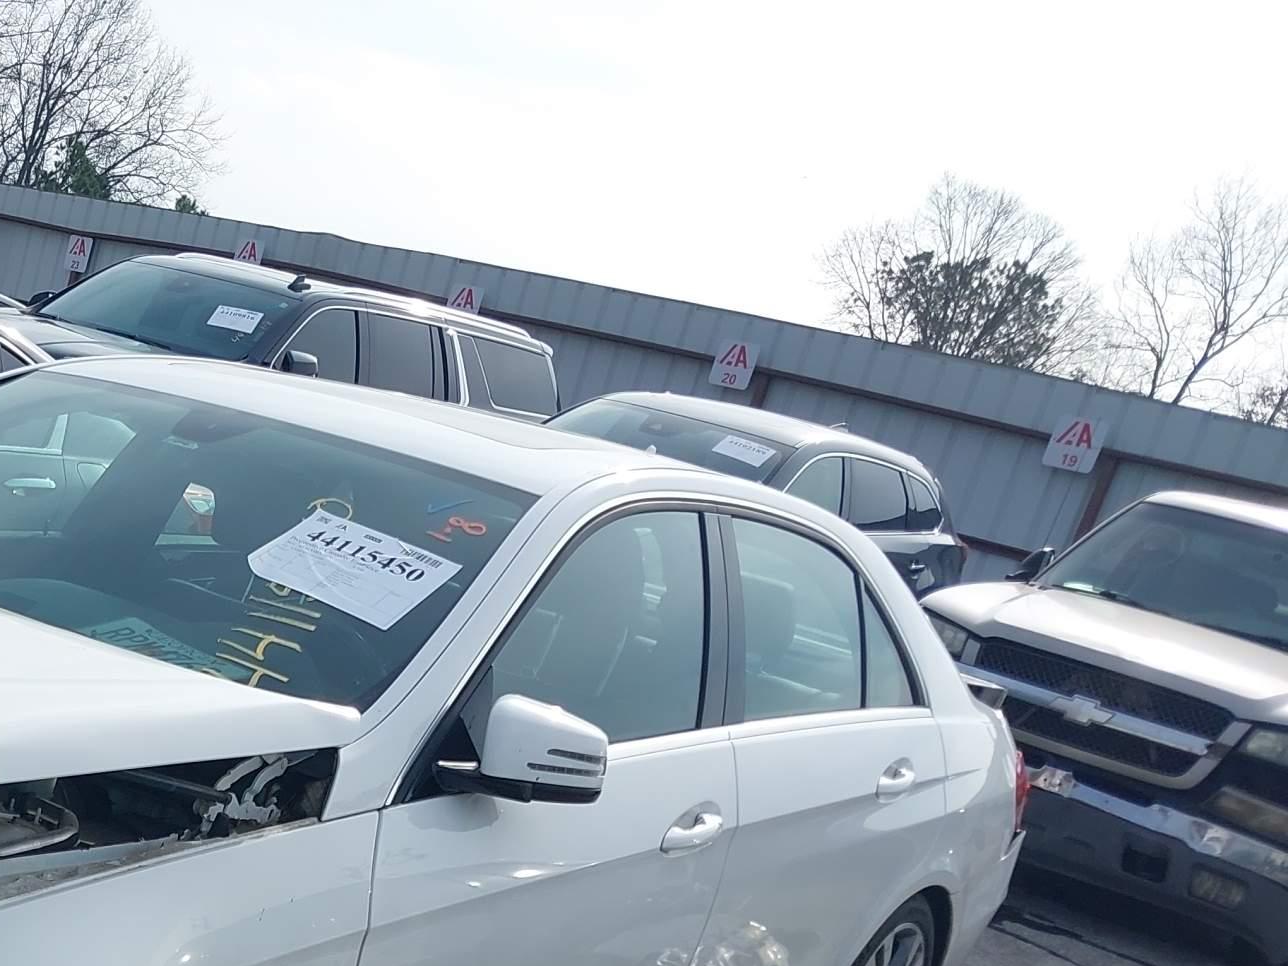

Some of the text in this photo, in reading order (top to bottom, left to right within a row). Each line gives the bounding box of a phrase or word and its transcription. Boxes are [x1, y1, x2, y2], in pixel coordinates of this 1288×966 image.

[70, 260, 80, 270] 23
[721, 373, 737, 385] 20
[1062, 454, 1078, 467] 19
[306, 529, 426, 583] 44115450
